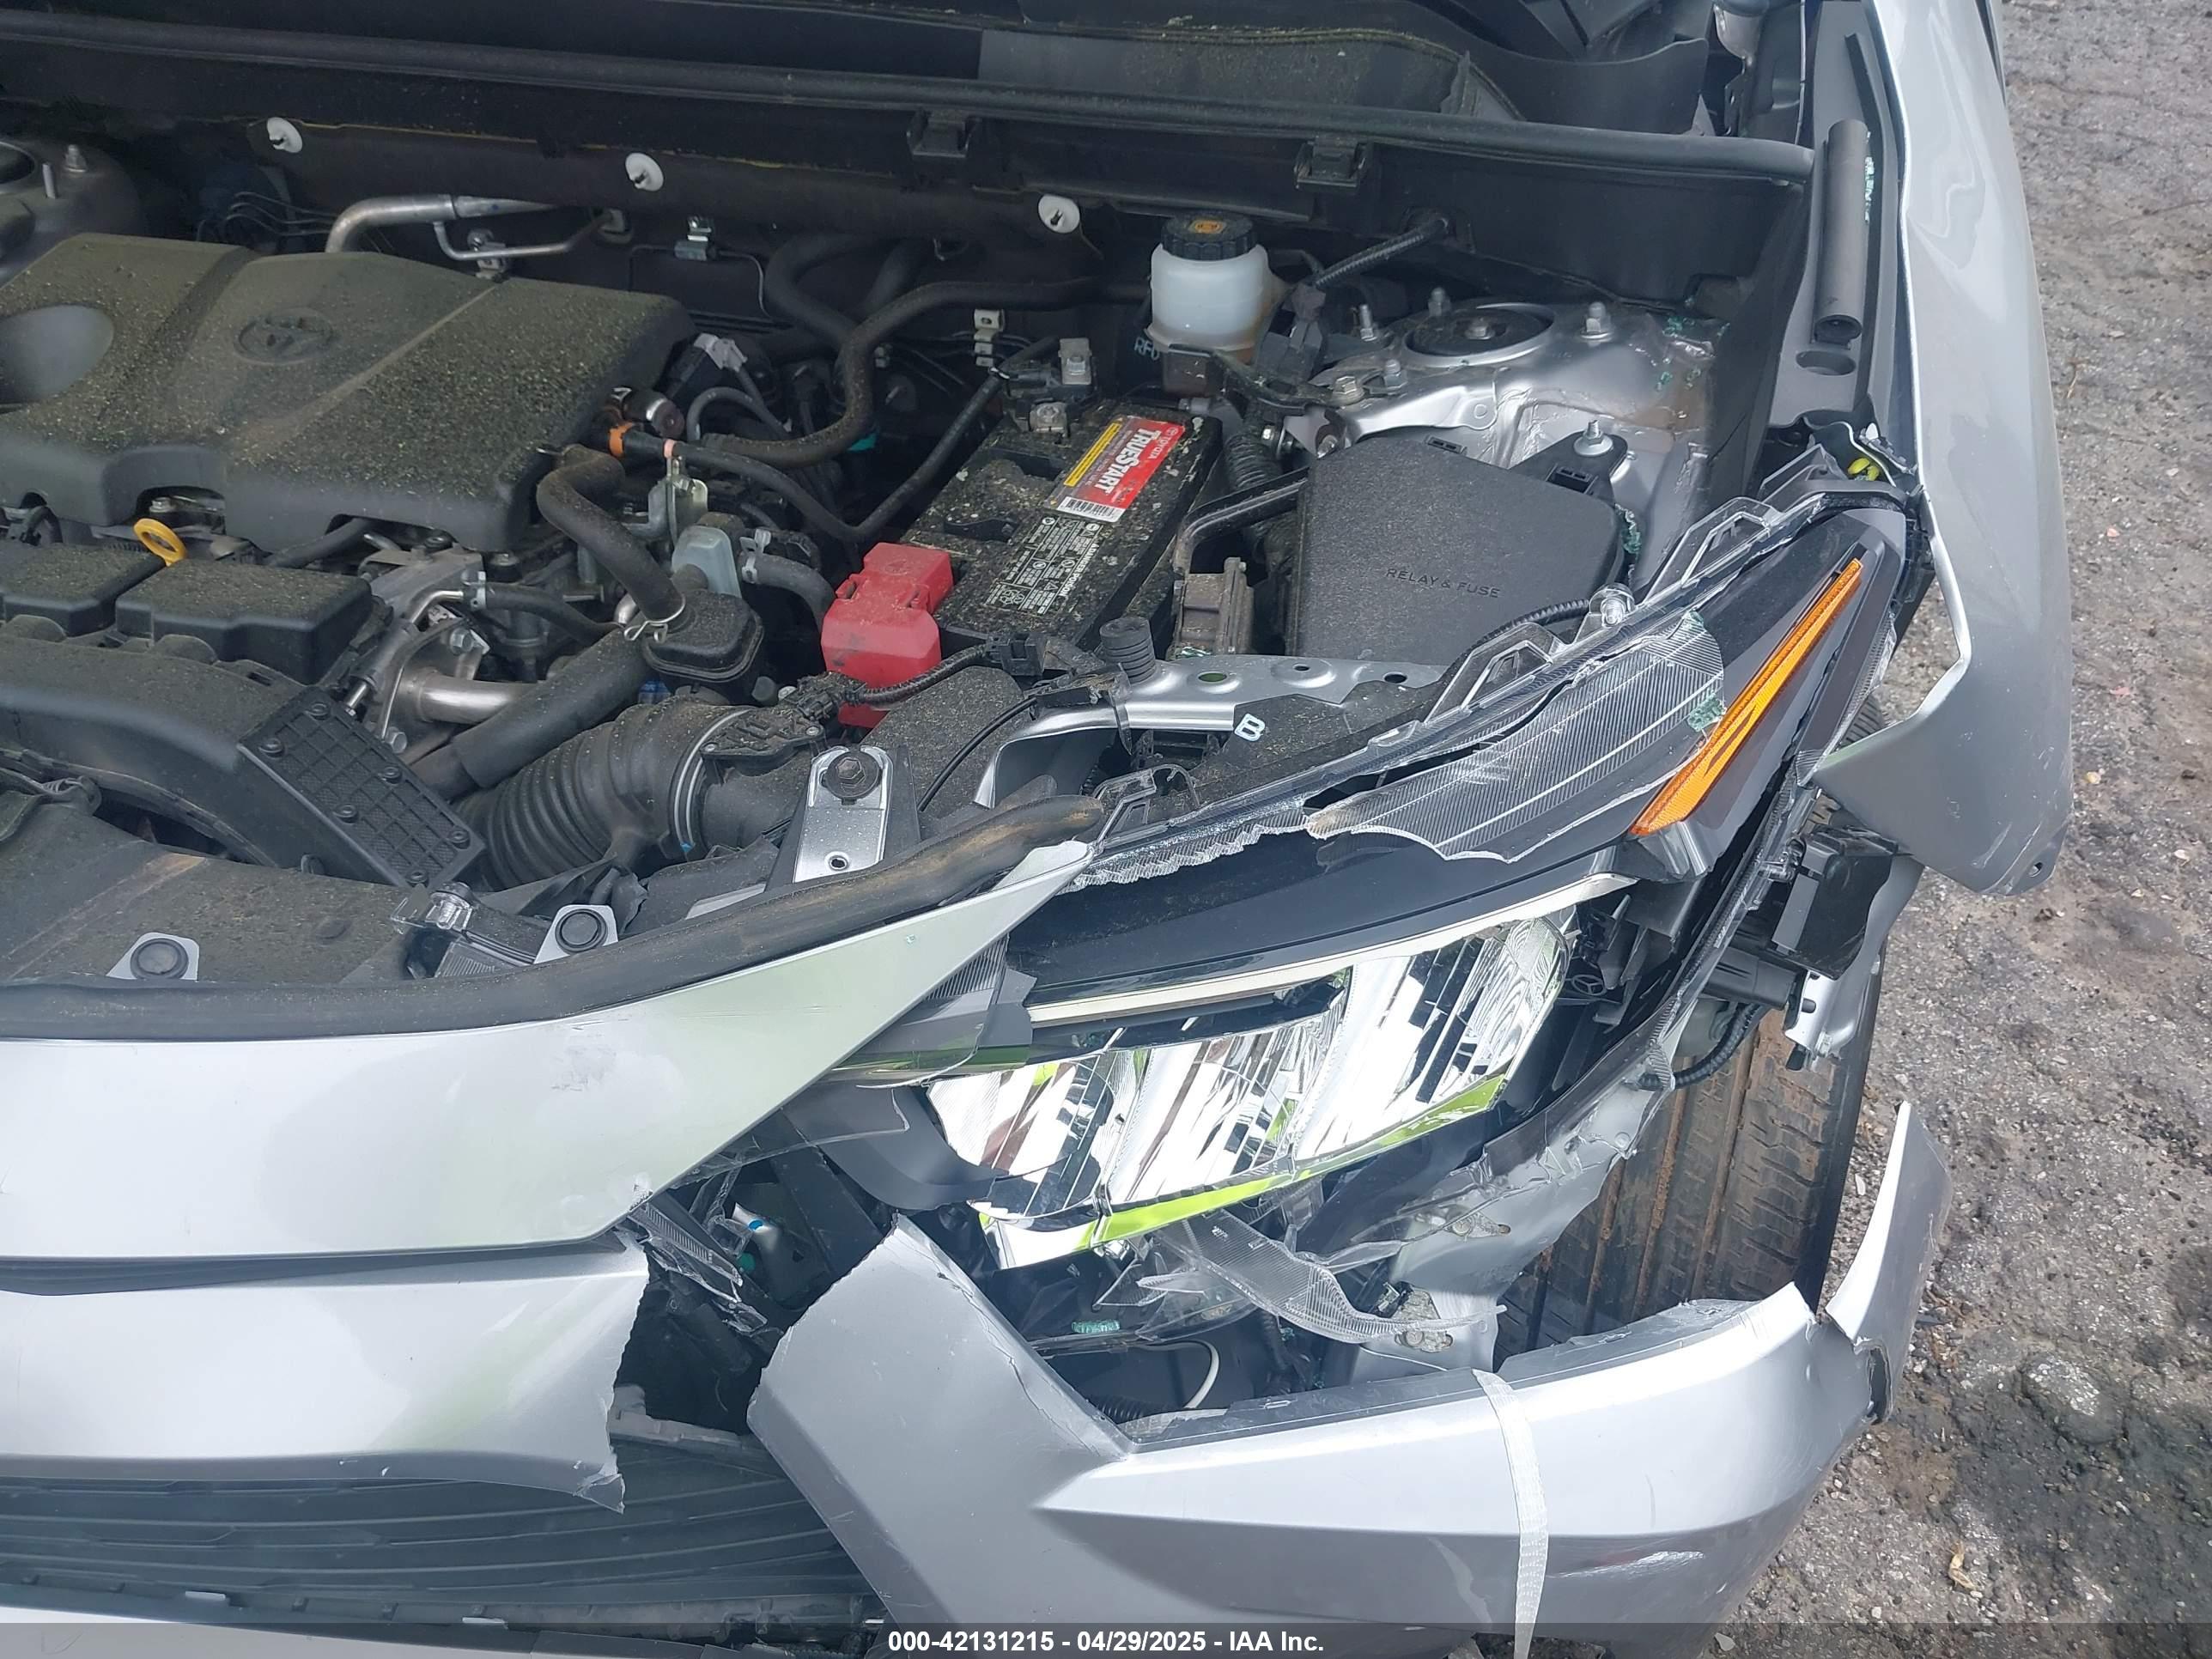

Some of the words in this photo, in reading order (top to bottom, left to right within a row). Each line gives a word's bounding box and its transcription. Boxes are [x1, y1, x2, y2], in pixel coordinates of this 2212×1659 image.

[1095, 428, 1162, 495] TRUESTART
[1146, 434, 1175, 459] TOYOTA
[1385, 568, 1439, 586] RELAY
[1440, 579, 1450, 589] &
[1455, 581, 1501, 599] FUSE
[1234, 713, 1266, 742] B
